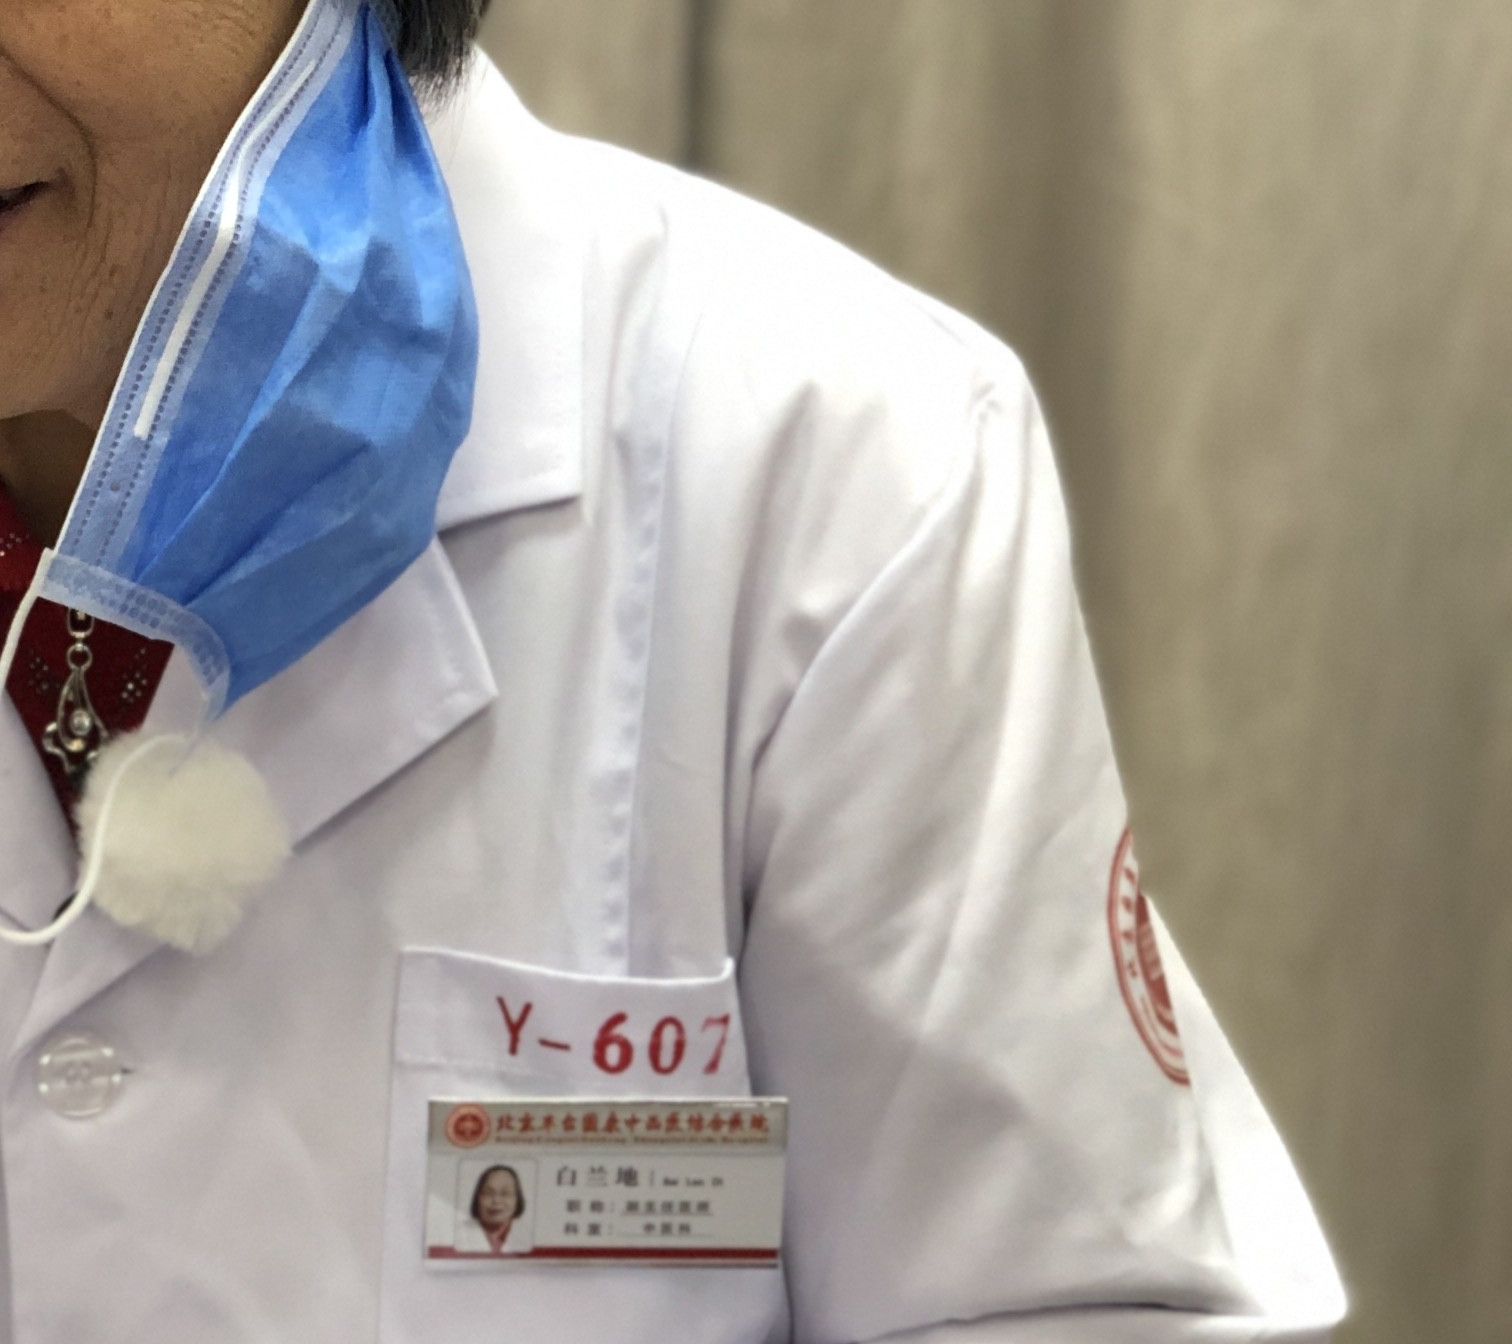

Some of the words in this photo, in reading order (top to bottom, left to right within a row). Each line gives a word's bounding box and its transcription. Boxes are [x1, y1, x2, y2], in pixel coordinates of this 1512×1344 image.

[495, 995, 731, 1076] Y-607
[556, 1166, 639, 1187] 白兰地
